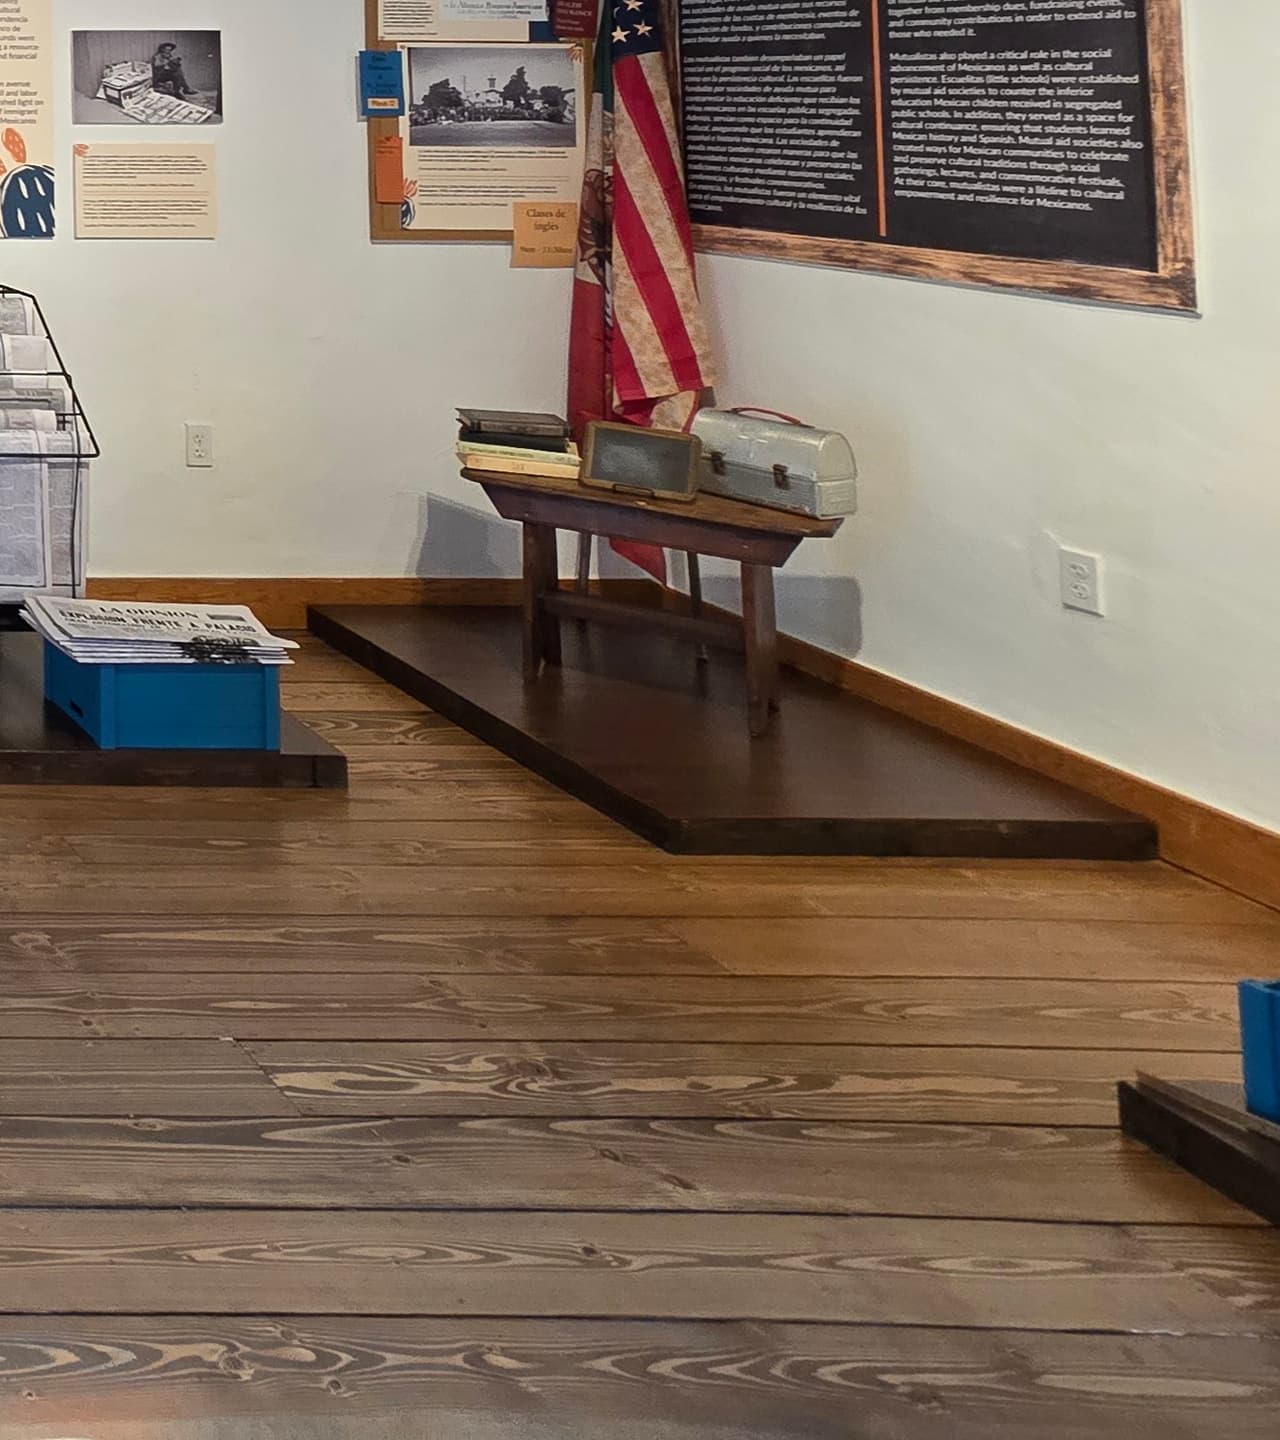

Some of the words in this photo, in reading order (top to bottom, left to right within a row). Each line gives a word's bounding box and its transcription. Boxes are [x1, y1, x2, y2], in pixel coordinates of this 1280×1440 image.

[997, 51, 1028, 59] critical
[1030, 50, 1049, 58] role
[1052, 50, 1060, 58] in
[1063, 50, 1079, 58] the
[1082, 49, 1111, 58] social
[527, 209, 553, 217] Clases
[555, 209, 566, 217] de
[126, 608, 198, 618] OPINION
[132, 617, 180, 627] FRENTE
[206, 623, 257, 632] PALACIO
